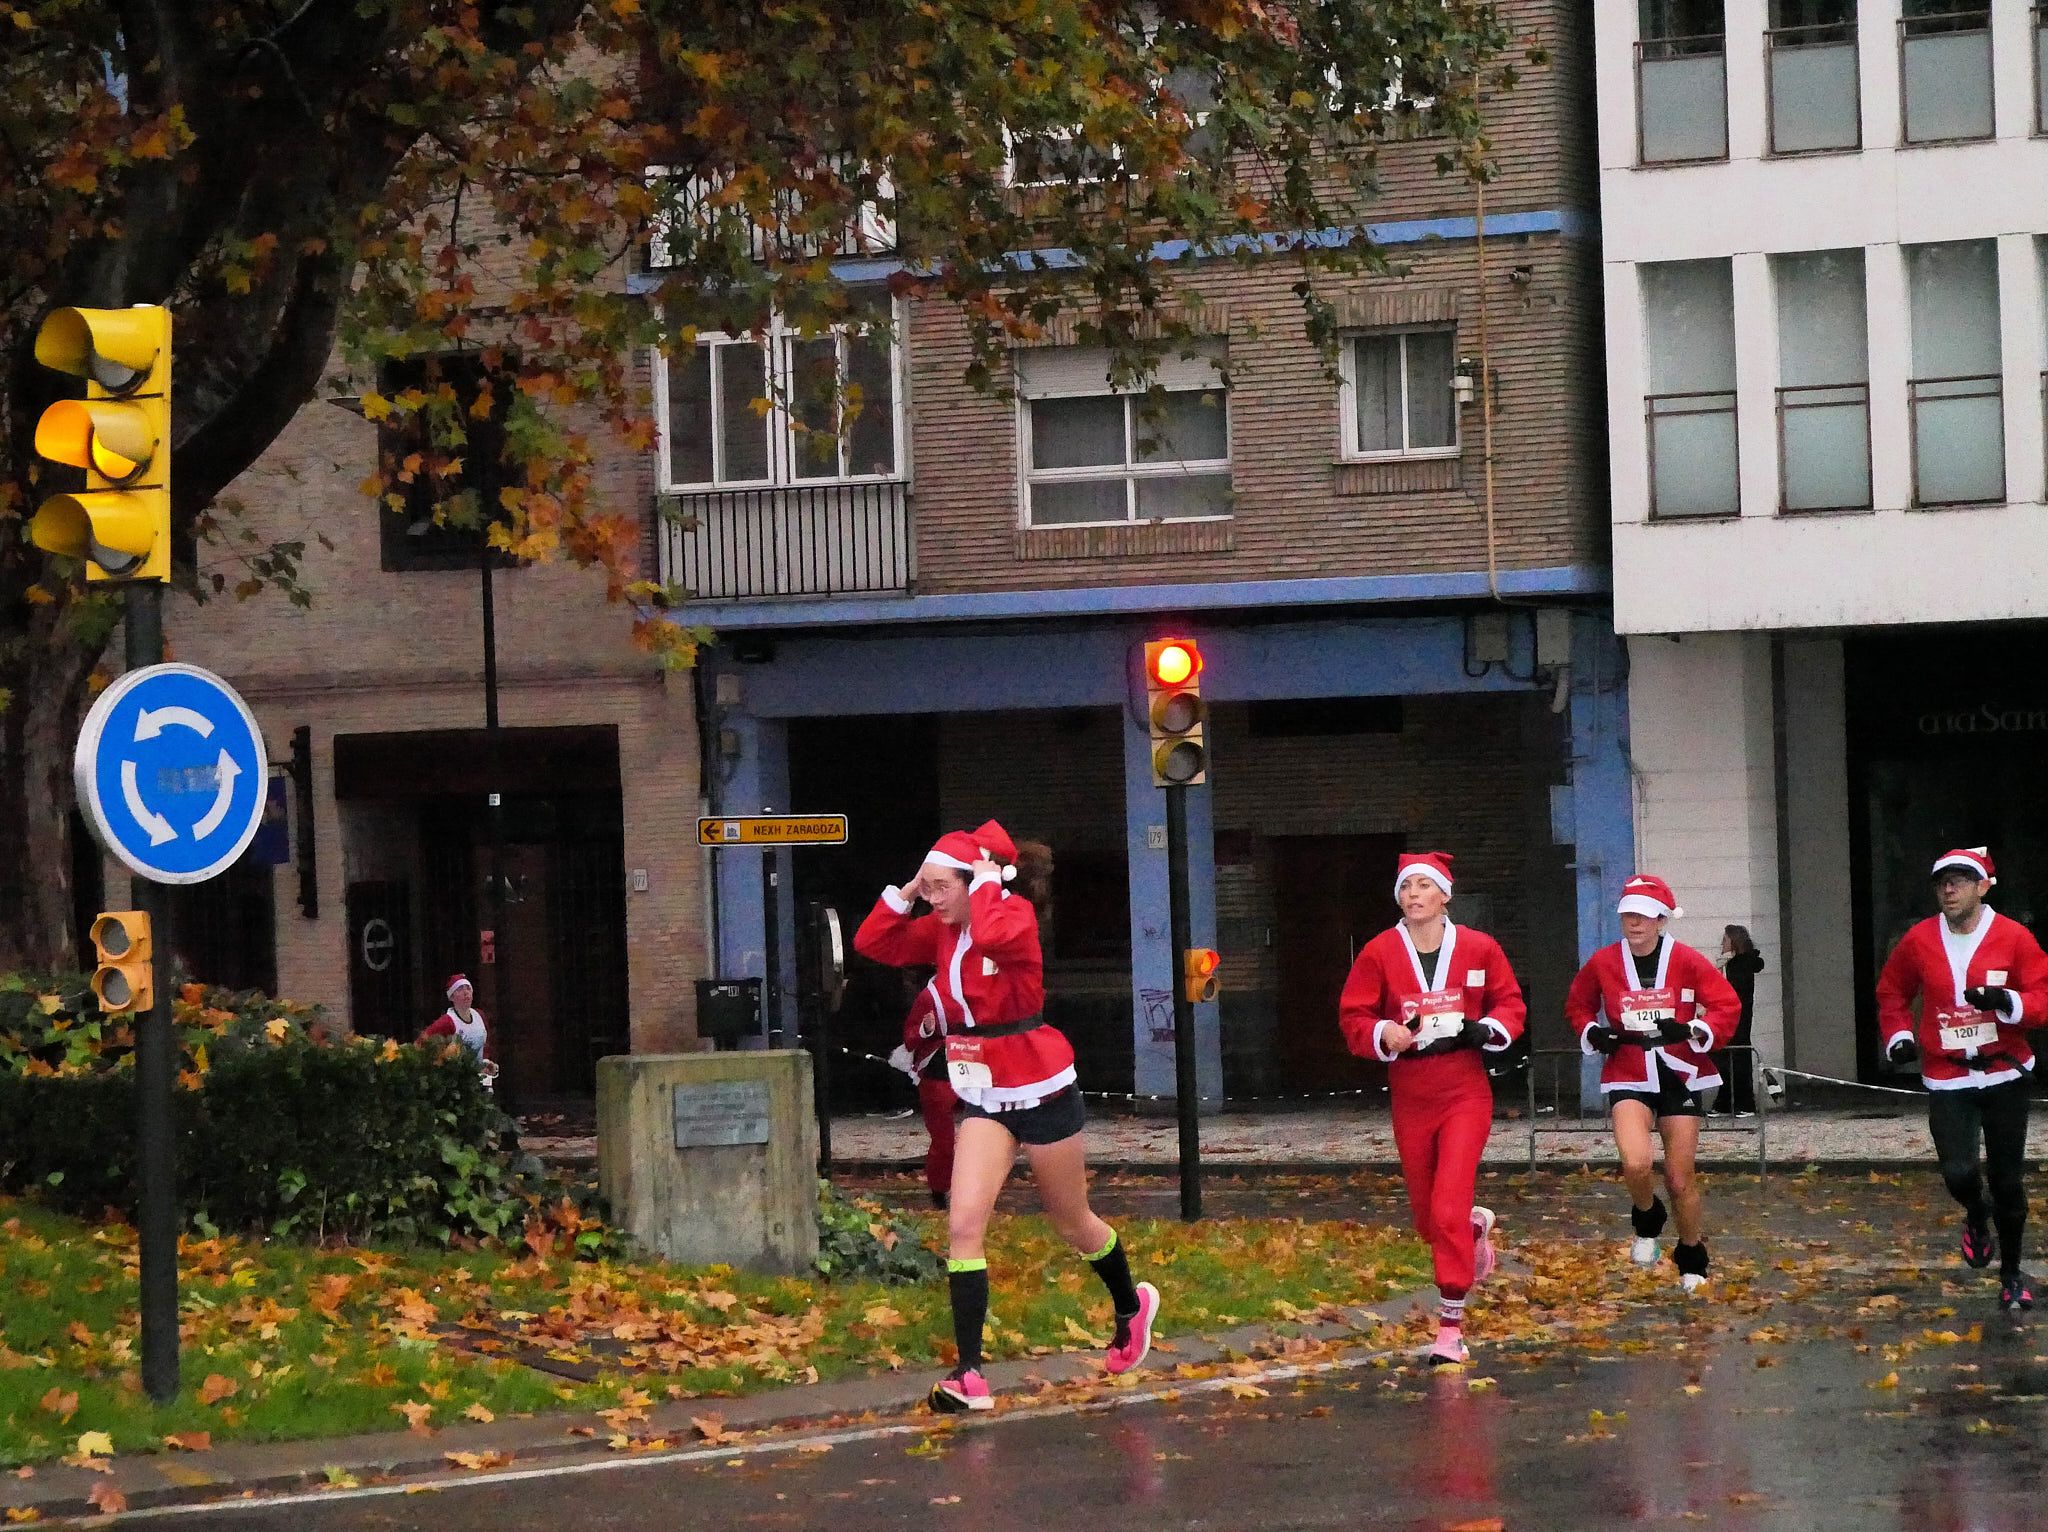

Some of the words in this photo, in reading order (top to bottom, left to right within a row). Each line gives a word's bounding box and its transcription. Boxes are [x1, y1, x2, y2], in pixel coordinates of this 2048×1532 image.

[753, 825, 781, 836] NEXH
[786, 823, 841, 835] ZARAGOZA
[1636, 1010, 1661, 1021] 1210
[1432, 1016, 1440, 1028] 2
[1954, 1026, 1979, 1038] 1207
